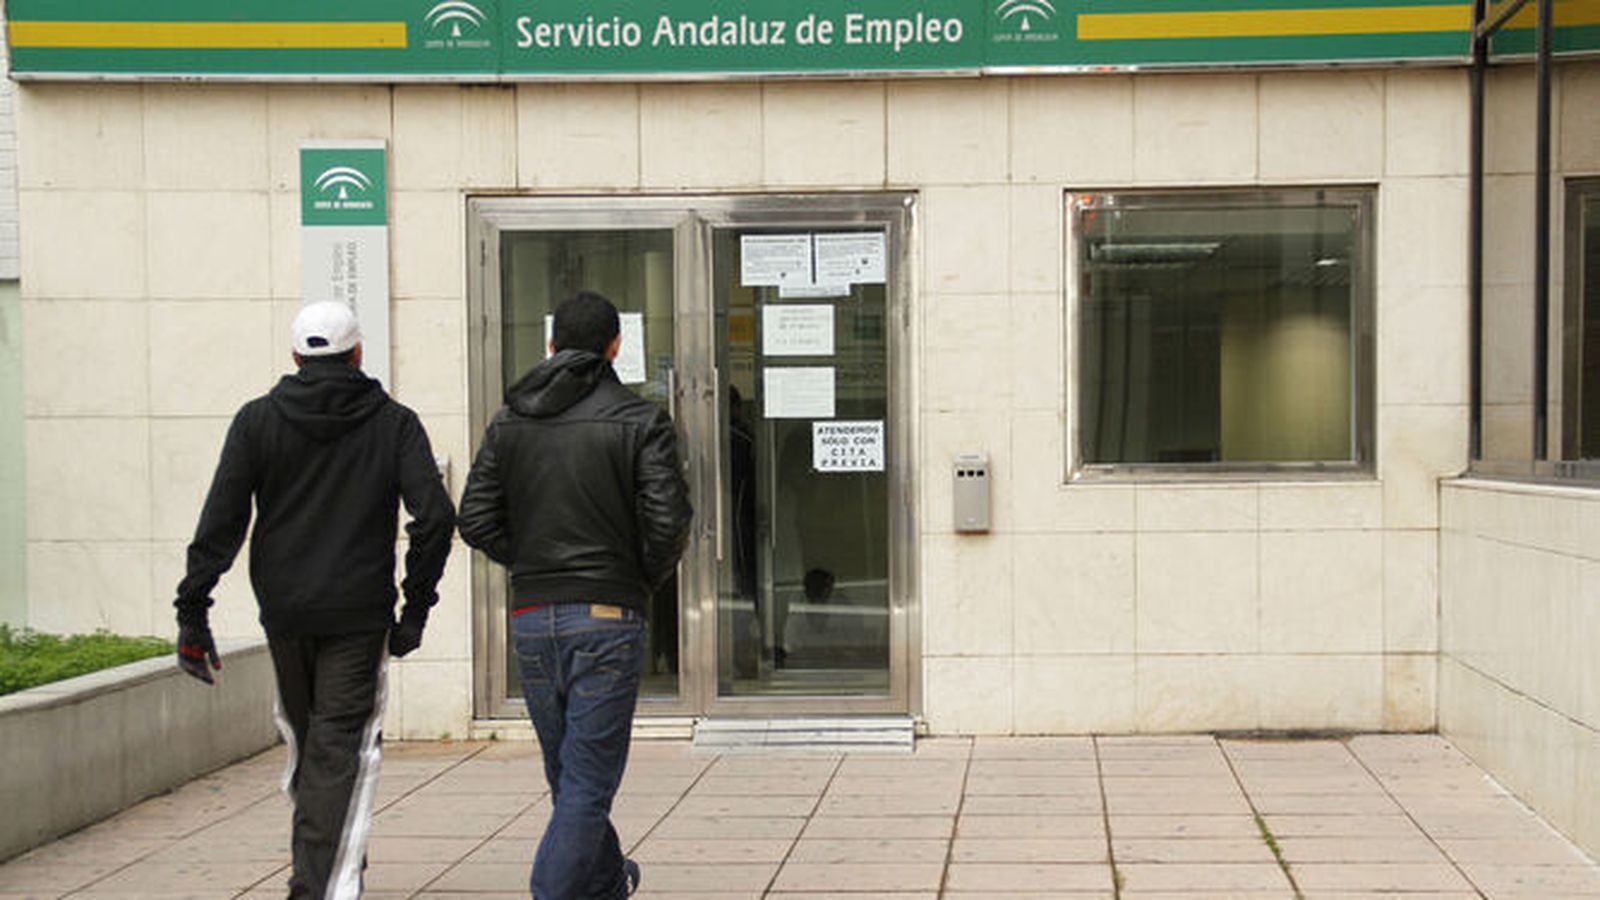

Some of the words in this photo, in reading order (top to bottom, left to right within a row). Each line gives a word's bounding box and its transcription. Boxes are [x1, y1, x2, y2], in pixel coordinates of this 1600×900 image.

[516, 16, 642, 47] Servicio
[651, 15, 786, 46] Andaluz
[795, 13, 833, 45] de
[844, 11, 964, 52] Empleo
[817, 425, 880, 436] ATENDEMOS
[852, 436, 876, 446] CON
[830, 446, 867, 457] CITA
[820, 458, 877, 468] PREVIA
